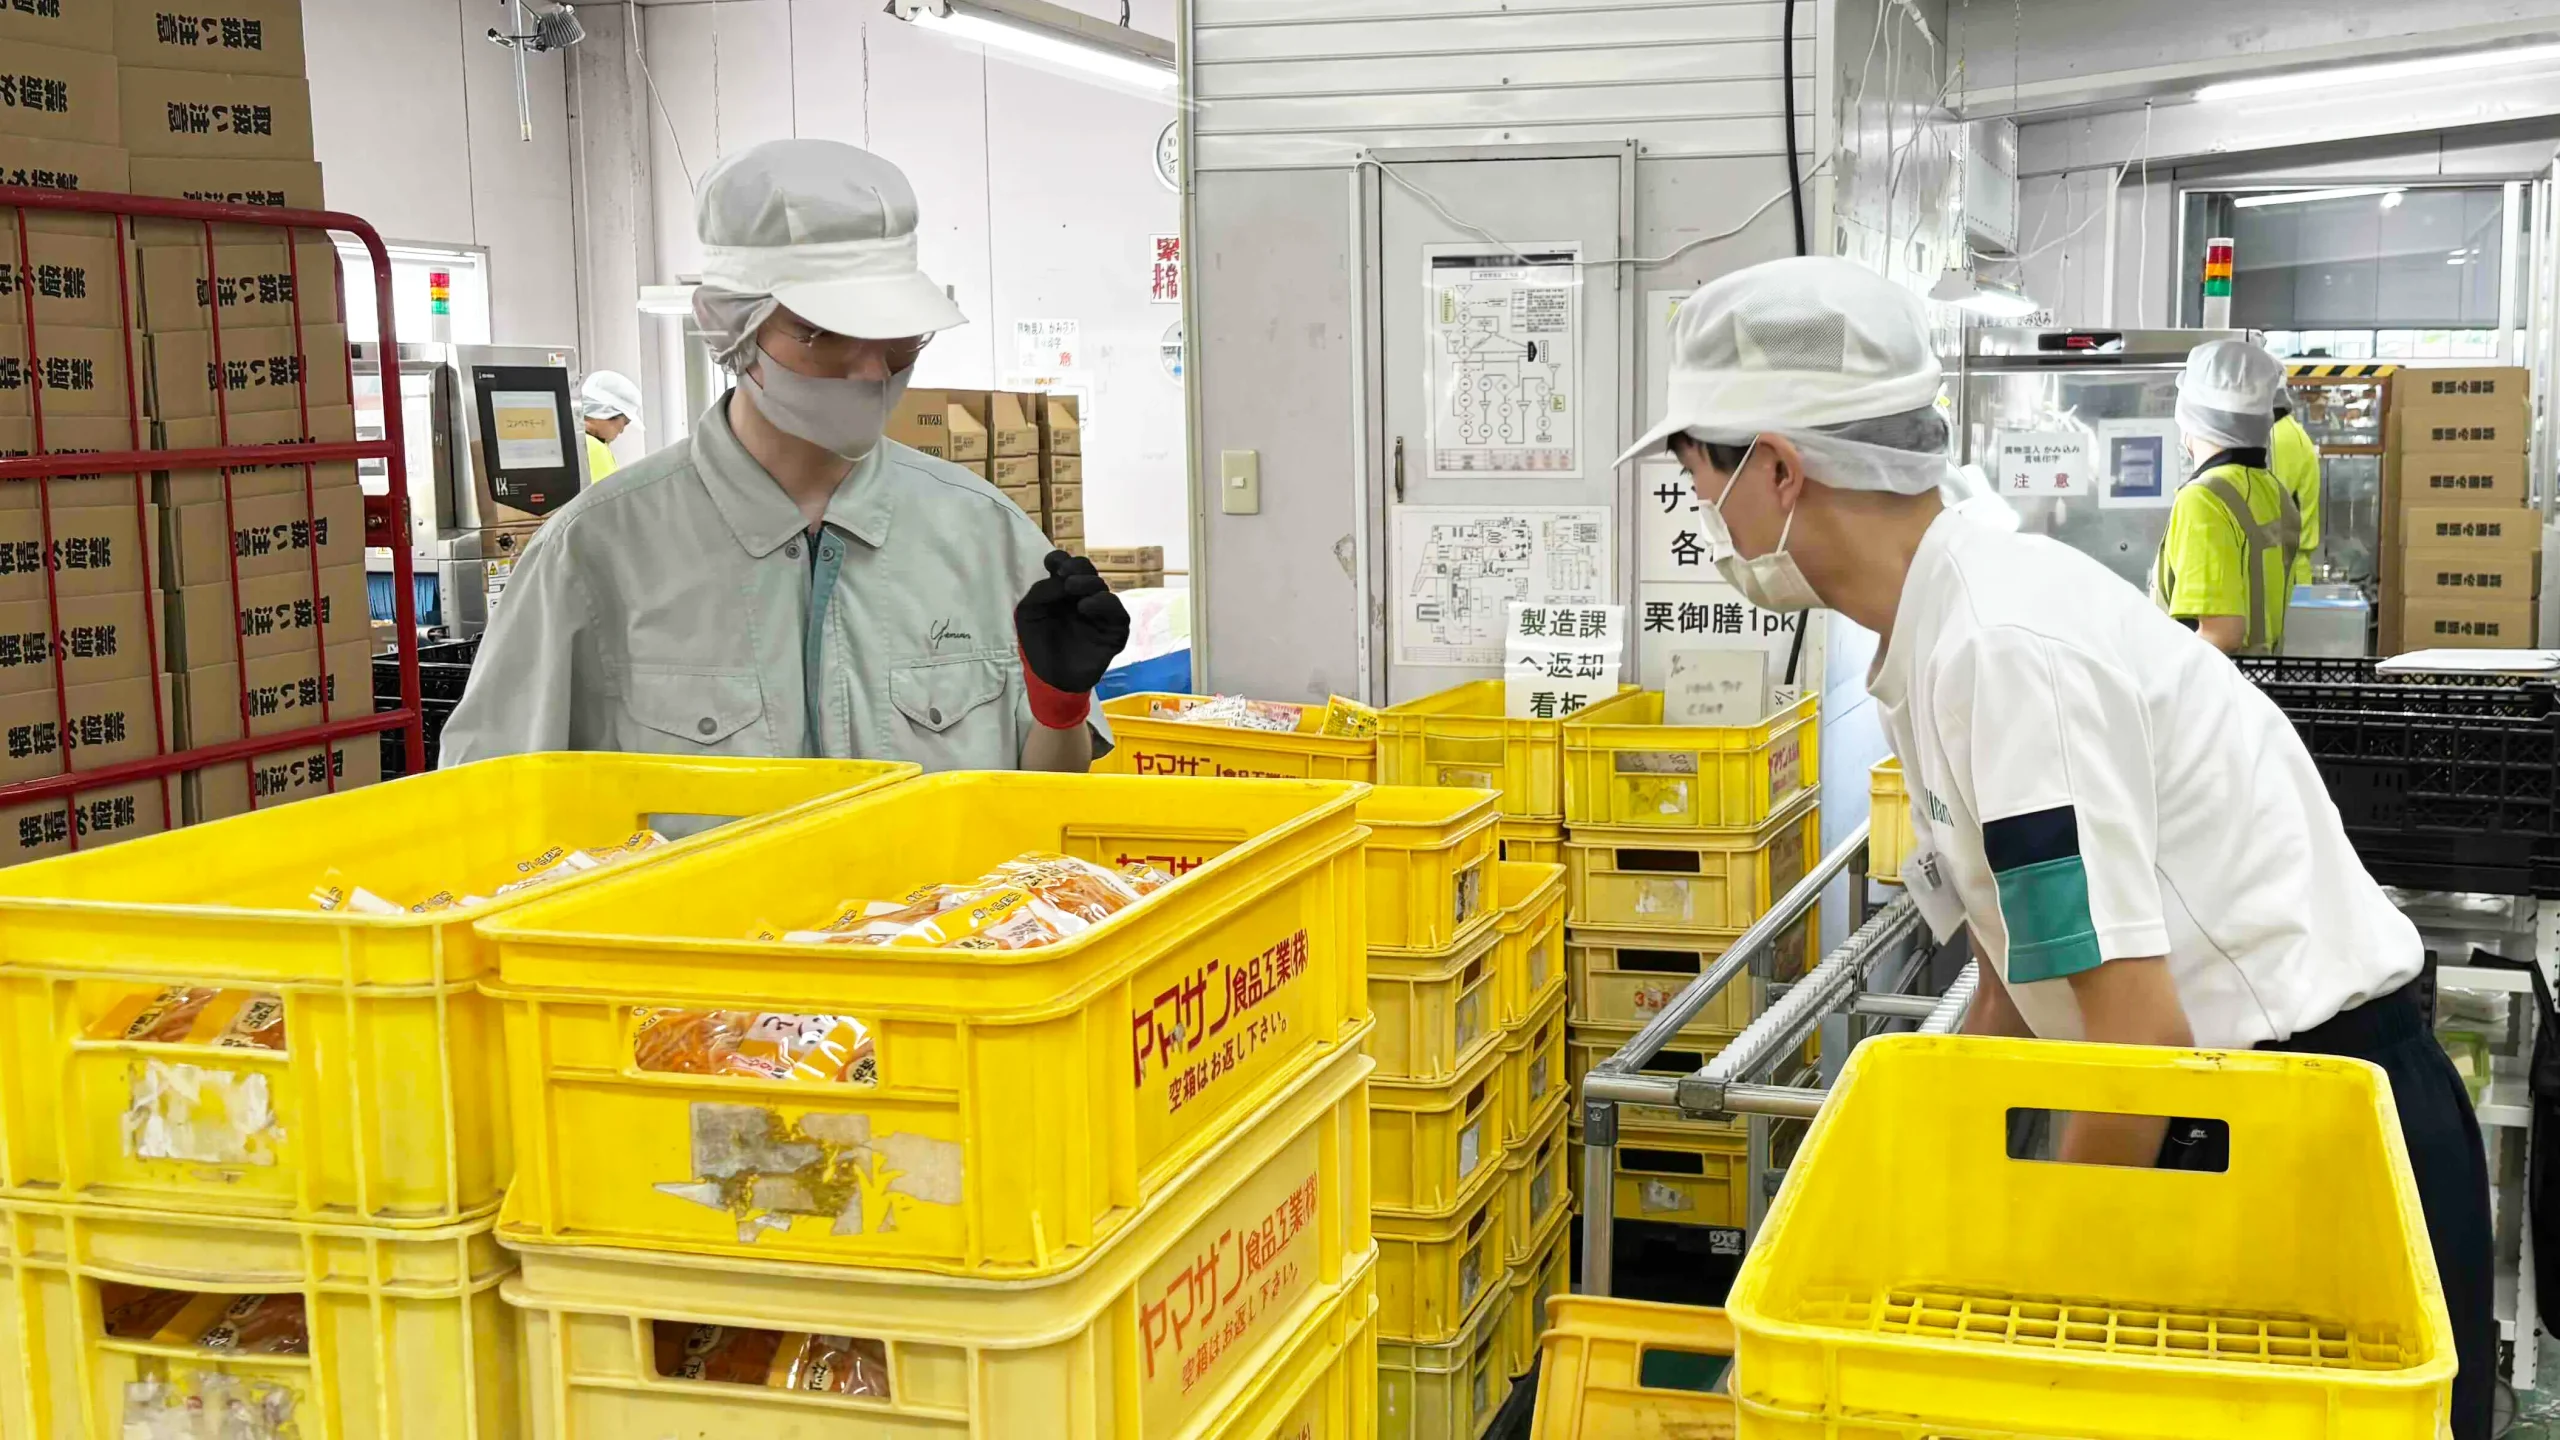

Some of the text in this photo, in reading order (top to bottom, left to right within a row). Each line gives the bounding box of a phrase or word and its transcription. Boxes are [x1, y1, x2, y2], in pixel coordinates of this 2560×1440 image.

[156, 13, 262, 51] 取扱い注意
[167, 101, 272, 136] 取扱い注意
[1519, 608, 1607, 639] 製造課
[1644, 602, 1796, 636] 栗御膳1pk
[1519, 652, 1604, 680] へ返却
[1133, 928, 1309, 1089] ヤマサン食品工業(株)
[1169, 1011, 1287, 1114] 空箱はお返し下さい。
